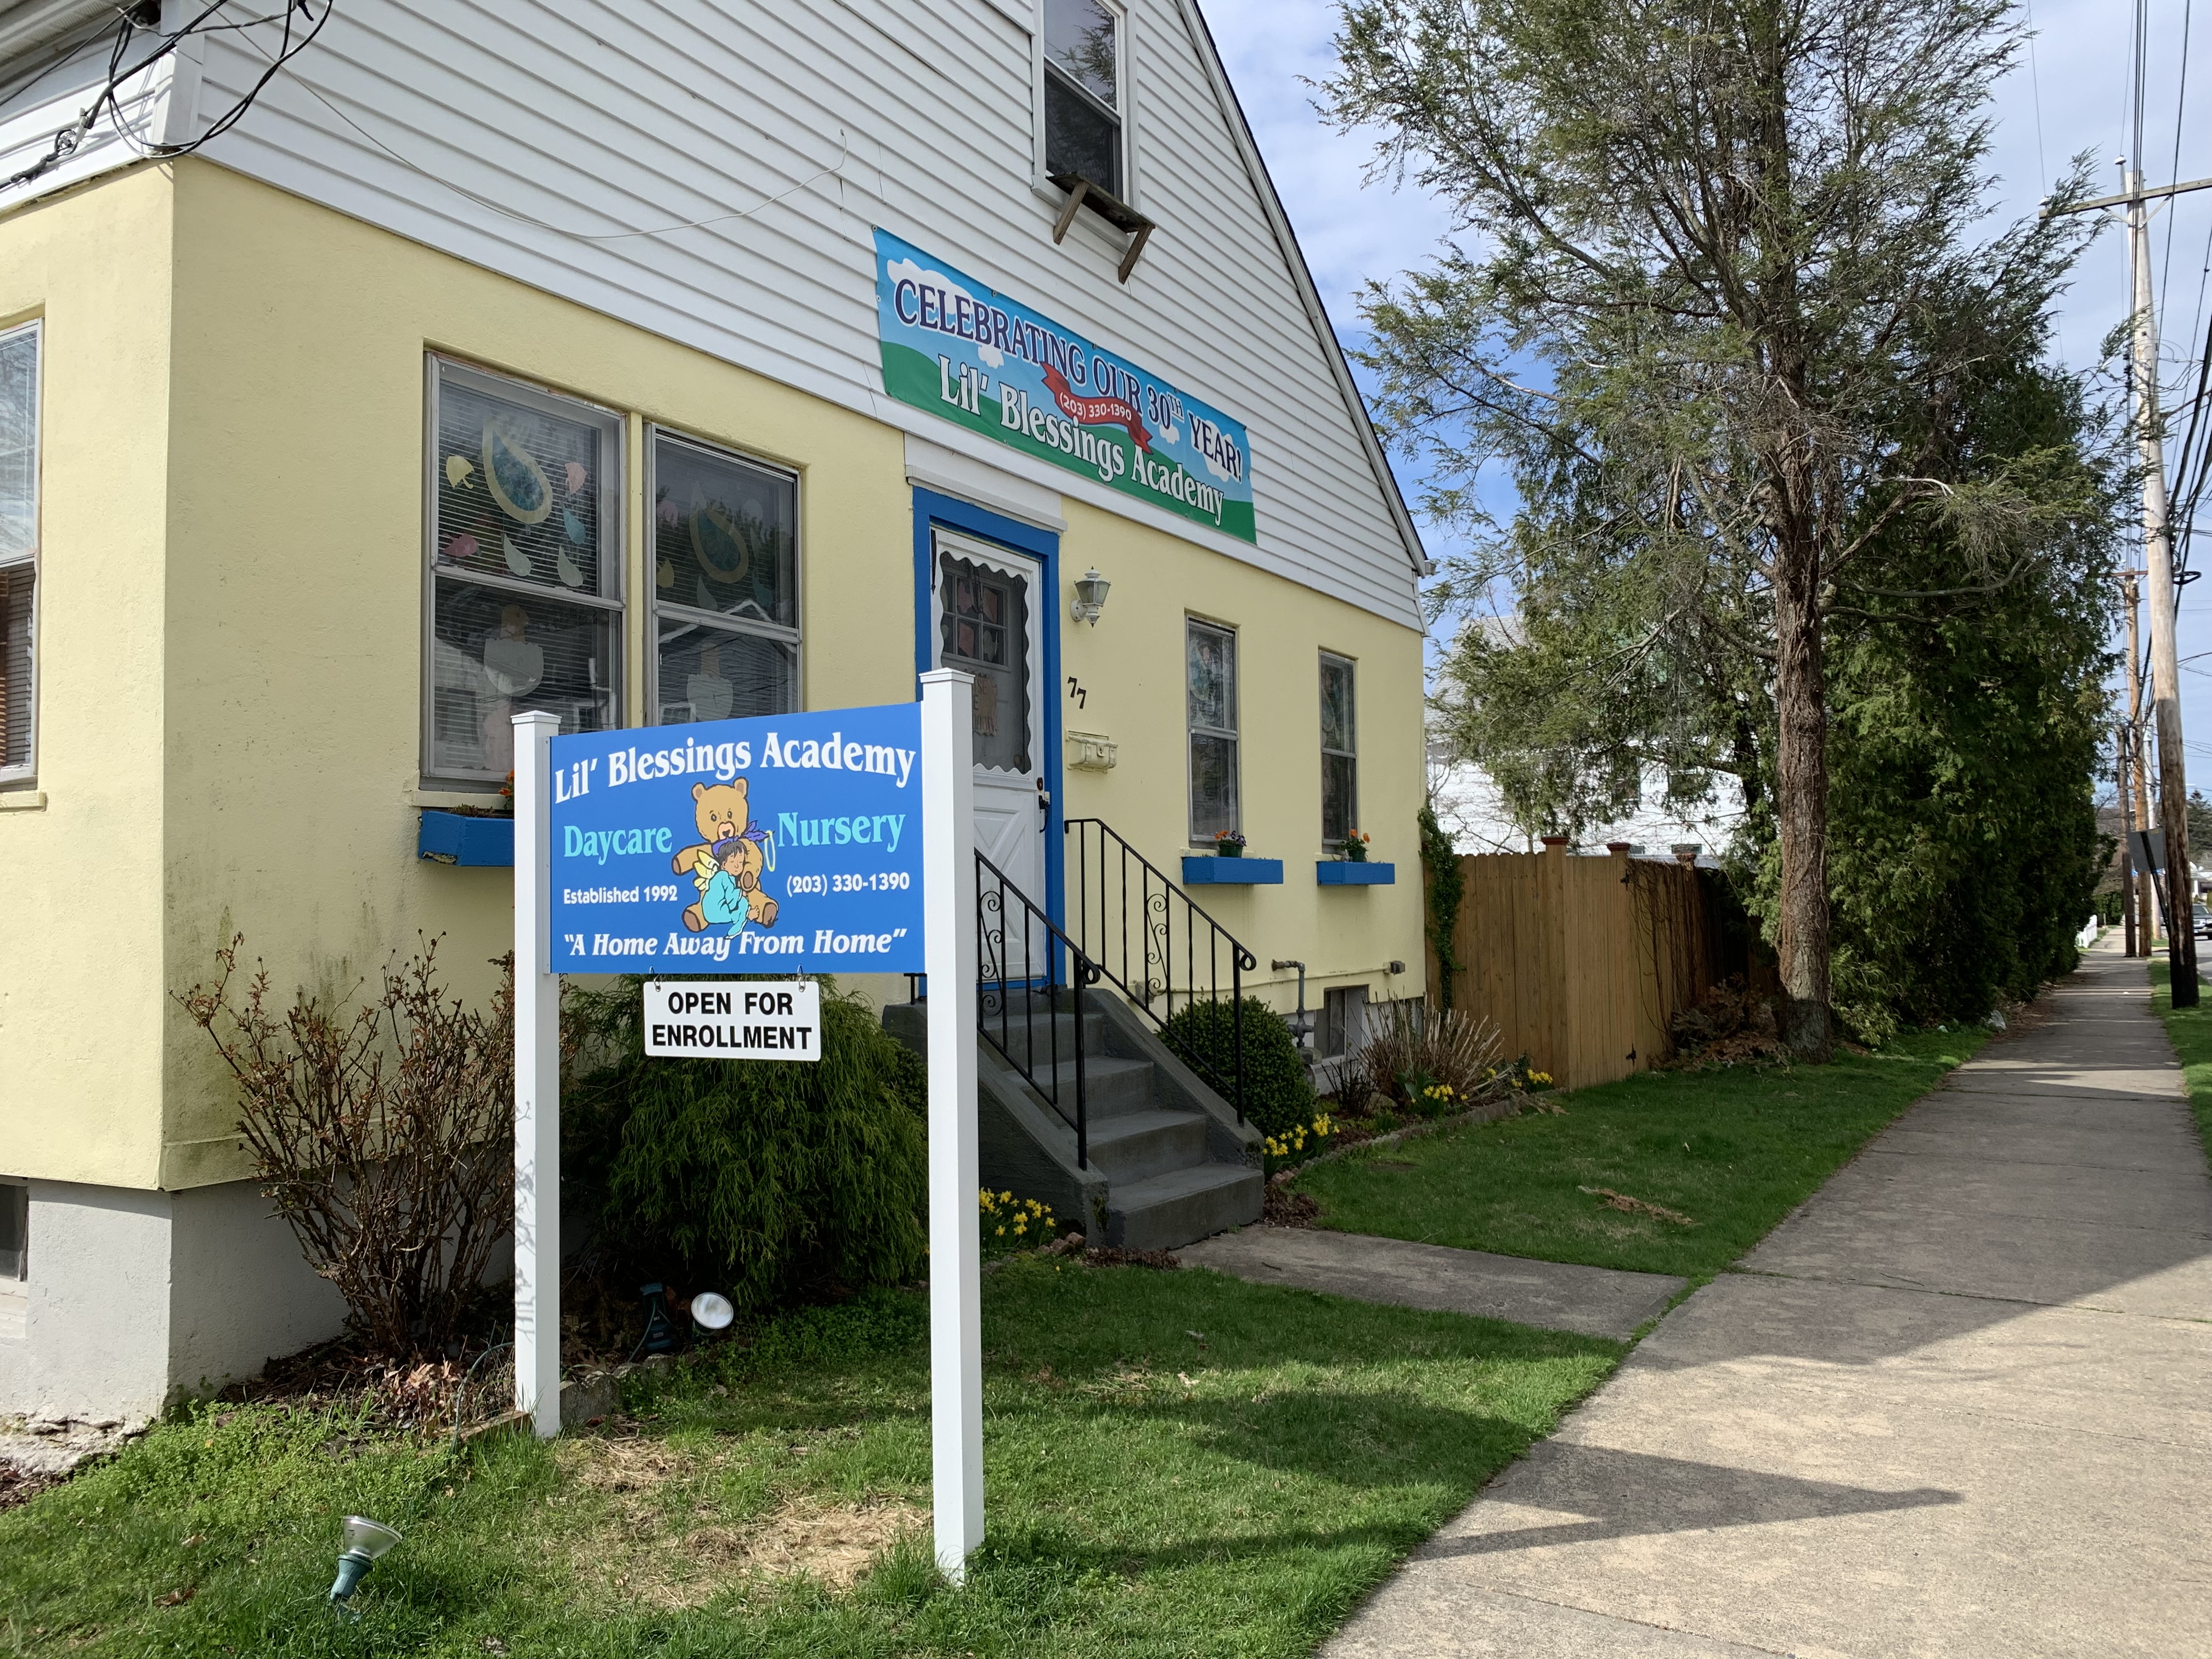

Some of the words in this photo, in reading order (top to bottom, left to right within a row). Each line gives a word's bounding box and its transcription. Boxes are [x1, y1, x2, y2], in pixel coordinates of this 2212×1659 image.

[895, 278, 1086, 385] CELEBRATING
[1093, 357, 1143, 415] OUR
[1188, 412, 1243, 482] YEAR!
[1059, 392, 1086, 420] (203)
[1088, 403, 1132, 421] 330-1390
[938, 353, 989, 416] Lil'
[998, 381, 1125, 482] Blessings
[1130, 444, 1224, 527] Academy
[1068, 676, 1087, 710] 77
[555, 758, 598, 804] Lil'
[608, 737, 752, 787] Blessings
[759, 731, 917, 788] Academy
[563, 825, 673, 866] Daycare
[777, 812, 906, 853] Nursery
[563, 886, 639, 905] Established
[644, 885, 678, 902] 1992
[787, 873, 828, 898] (203)
[832, 872, 910, 893] 330-1390
[564, 934, 586, 956] "A
[591, 933, 658, 956] Home
[662, 932, 731, 962] Away
[738, 930, 805, 955] From
[812, 928, 908, 954] Home"
[668, 991, 732, 1015] OPEN
[744, 992, 793, 1015] FOR
[652, 1024, 812, 1050] ENROLLMENT
